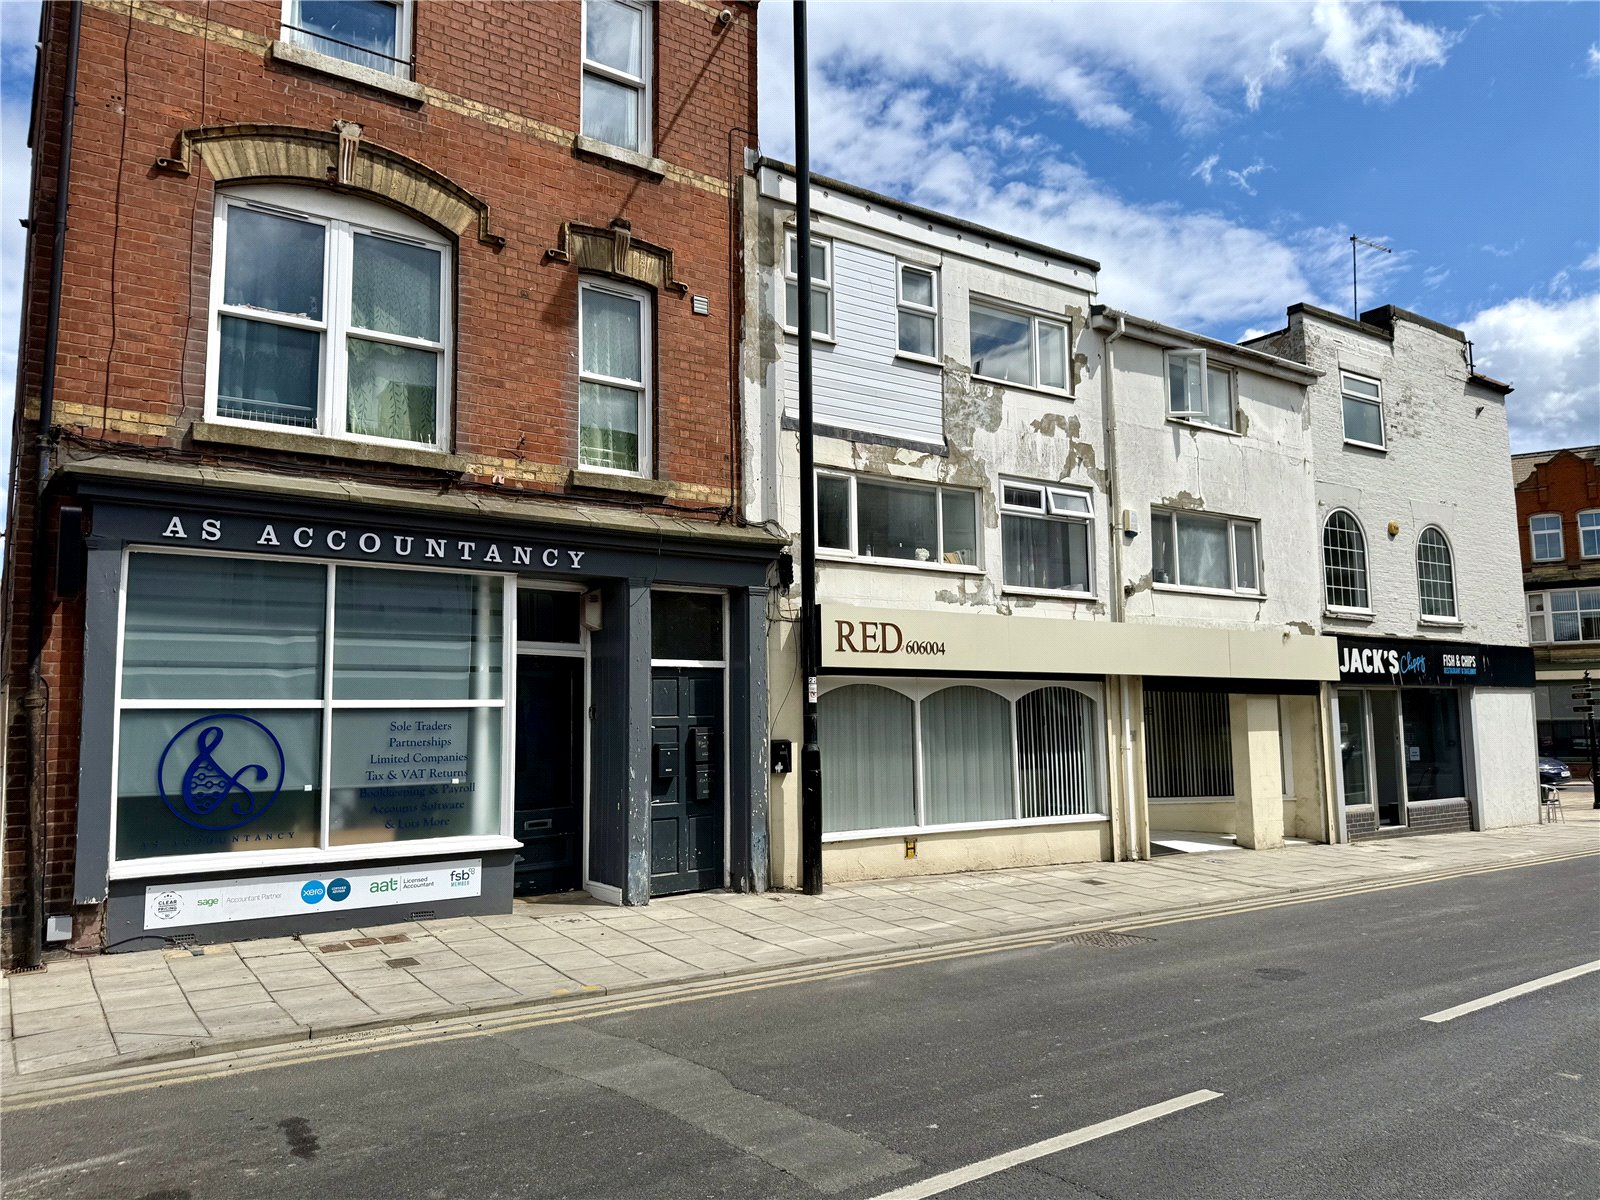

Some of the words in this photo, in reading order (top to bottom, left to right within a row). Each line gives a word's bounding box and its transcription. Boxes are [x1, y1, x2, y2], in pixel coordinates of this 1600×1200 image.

[162, 516, 222, 541] AS
[257, 524, 585, 569] ACCOUNTANCY
[834, 620, 903, 654] RED
[905, 640, 946, 656] 606004
[1340, 648, 1400, 675] JACK'S
[1400, 651, 1426, 674] Chippy
[1443, 654, 1455, 667] FISH
[1455, 654, 1461, 667] &
[1461, 655, 1476, 667] CHIPS
[390, 720, 412, 732] Sole
[415, 720, 452, 731] Traders
[389, 736, 452, 749] Partnerships
[370, 753, 410, 765] Limited
[412, 752, 469, 765] Companies
[366, 770, 385, 781] Tax
[387, 769, 398, 780] &
[401, 768, 426, 779] VAT
[429, 768, 469, 778] Returns
[429, 784, 439, 794] &
[442, 783, 476, 795] Payroll
[422, 801, 465, 811] Software
[384, 820, 395, 829] &
[423, 816, 450, 827] More
[172, 831, 296, 848] COUNTANCY
[403, 876, 428, 885] Licensed
[450, 869, 470, 882] fsb
[370, 878, 398, 893] aat
[403, 881, 435, 889] Accountant
[226, 893, 261, 904] Accountant
[261, 892, 283, 901] Partner
[303, 889, 324, 897] xero
[197, 897, 219, 907] sage
